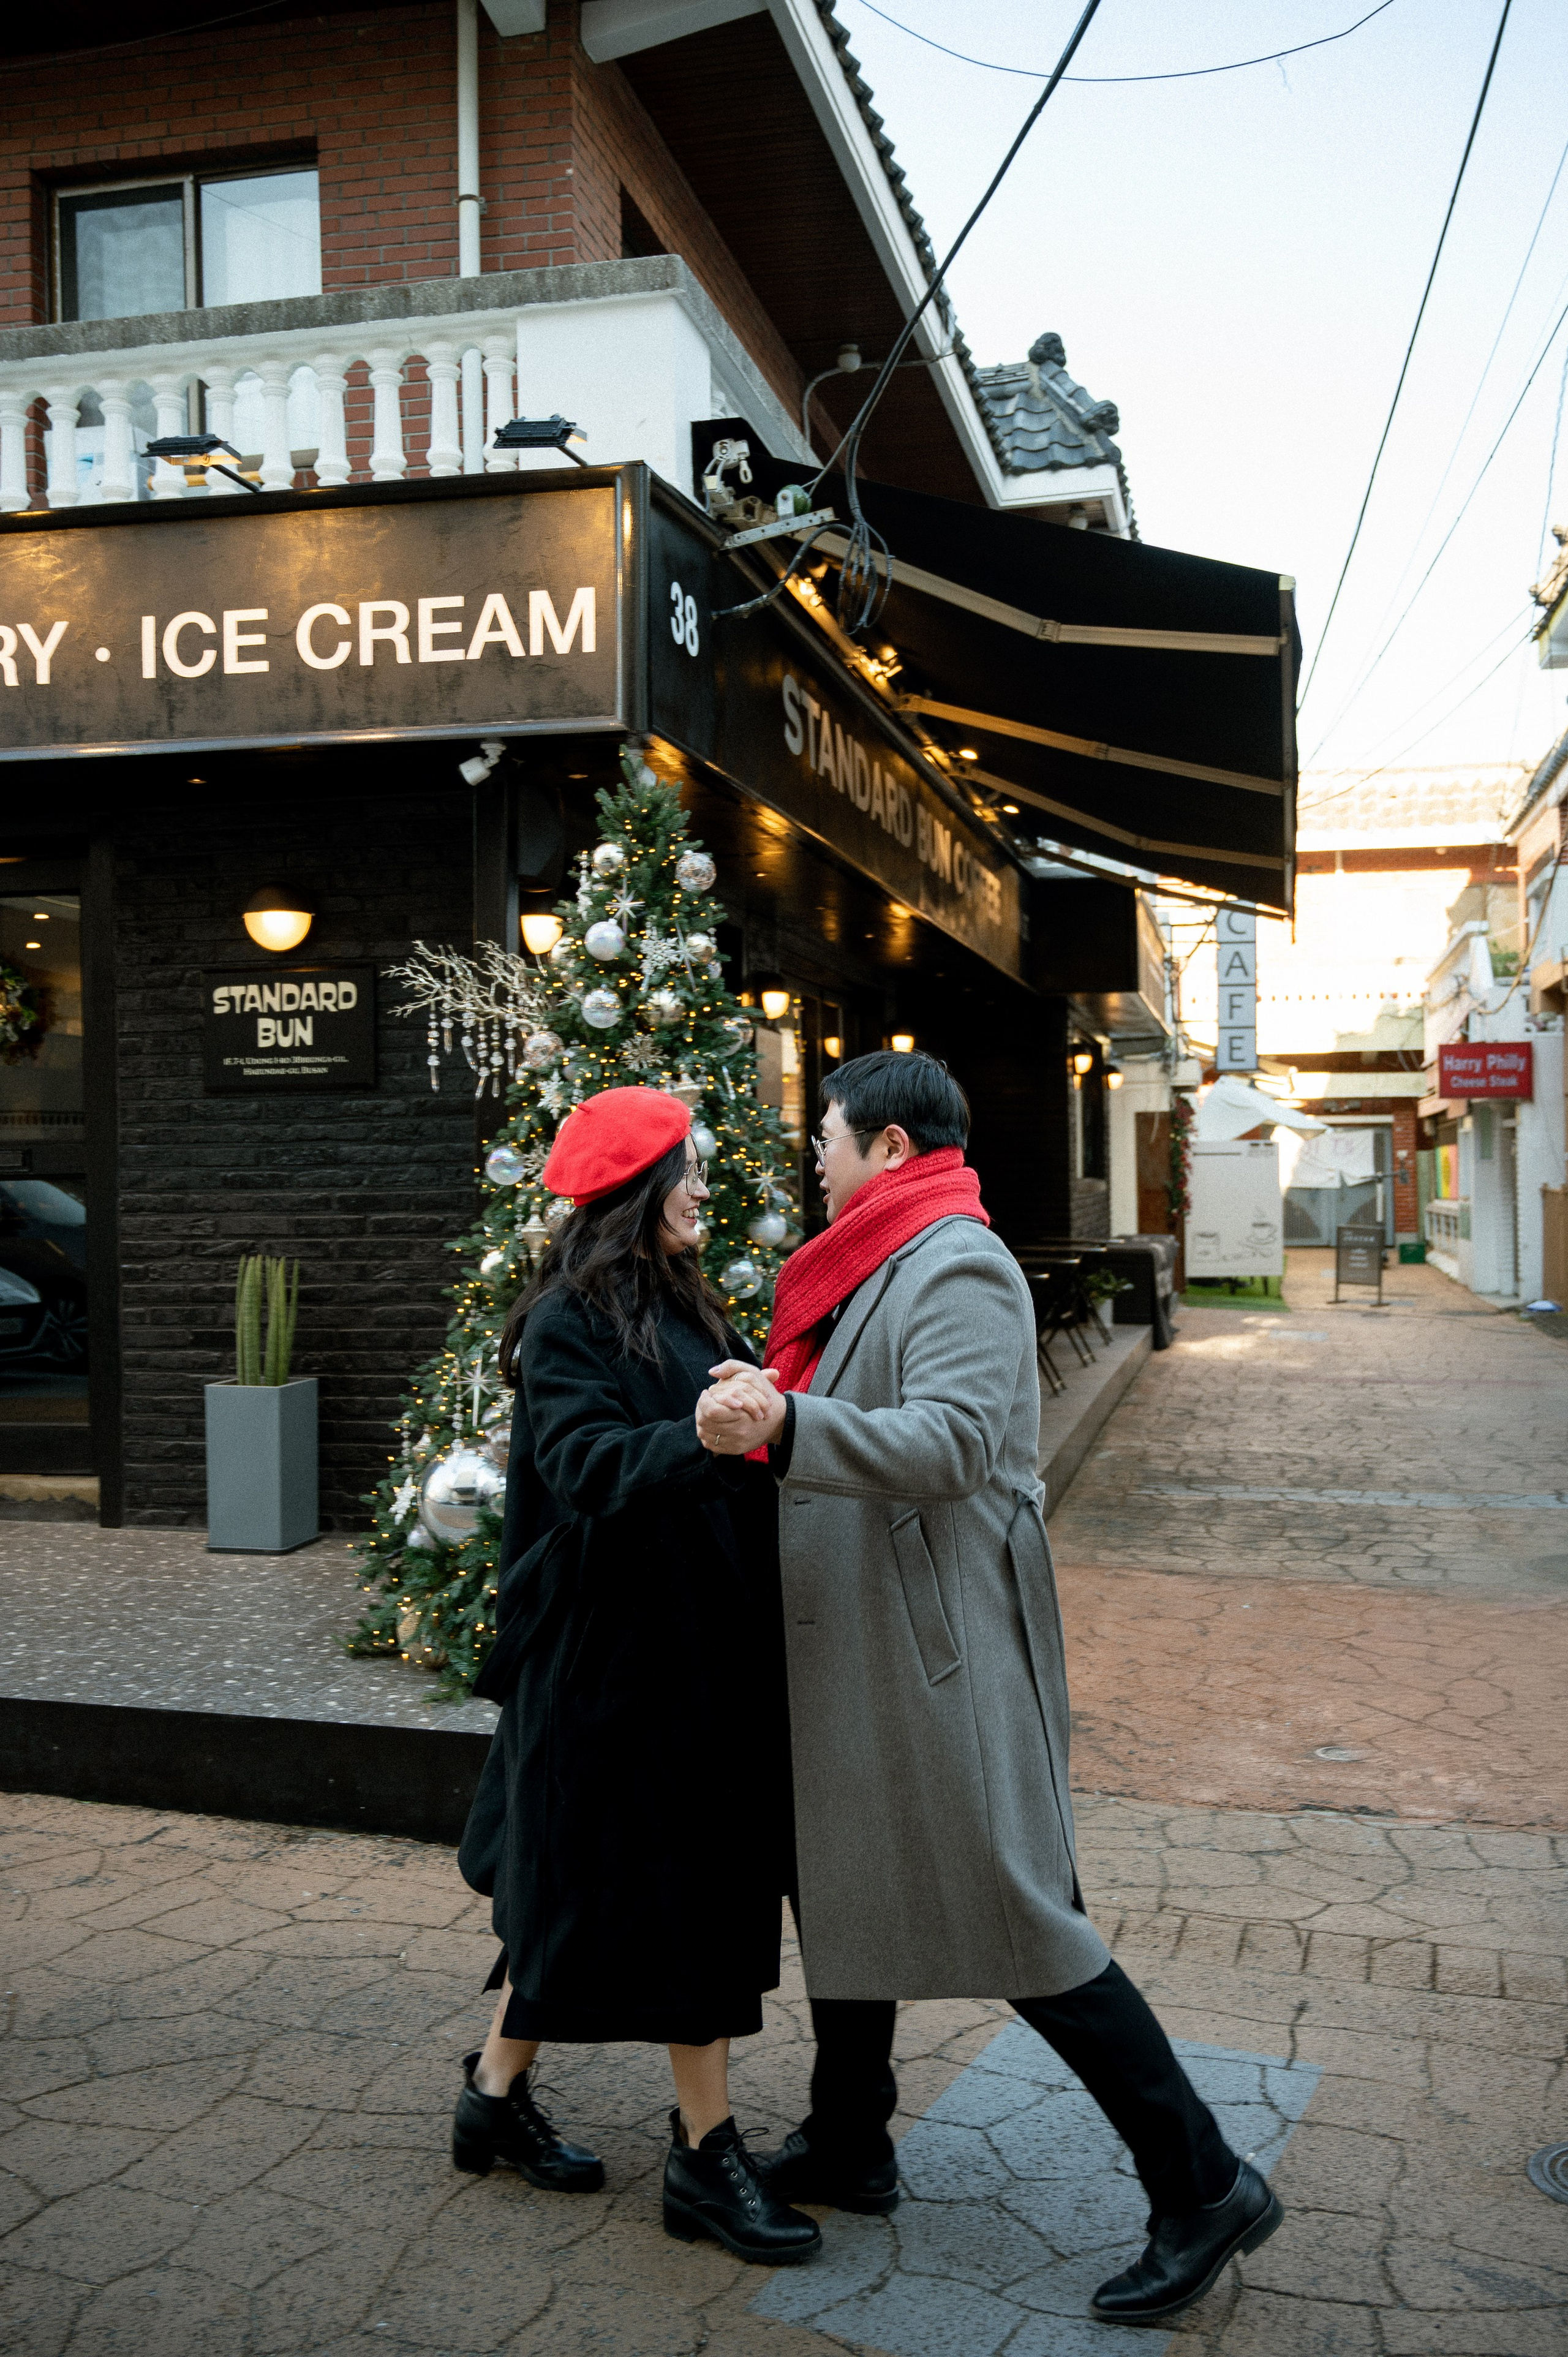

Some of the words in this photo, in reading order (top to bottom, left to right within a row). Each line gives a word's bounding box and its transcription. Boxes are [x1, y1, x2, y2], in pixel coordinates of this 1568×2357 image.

[141, 608, 270, 679] ICE
[296, 586, 597, 671] CREAM
[670, 581, 699, 657] 38
[782, 674, 913, 848] STANDARD
[916, 802, 952, 884] BUN
[212, 981, 358, 1014] STANDARD
[1226, 911, 1248, 1063] CAFE
[257, 1016, 314, 1048] BUN
[1442, 1055, 1483, 1074] Harry
[1486, 1053, 1526, 1072] Philly
[1450, 1075, 1487, 1088] Cheese
[1489, 1074, 1518, 1087] Steak
